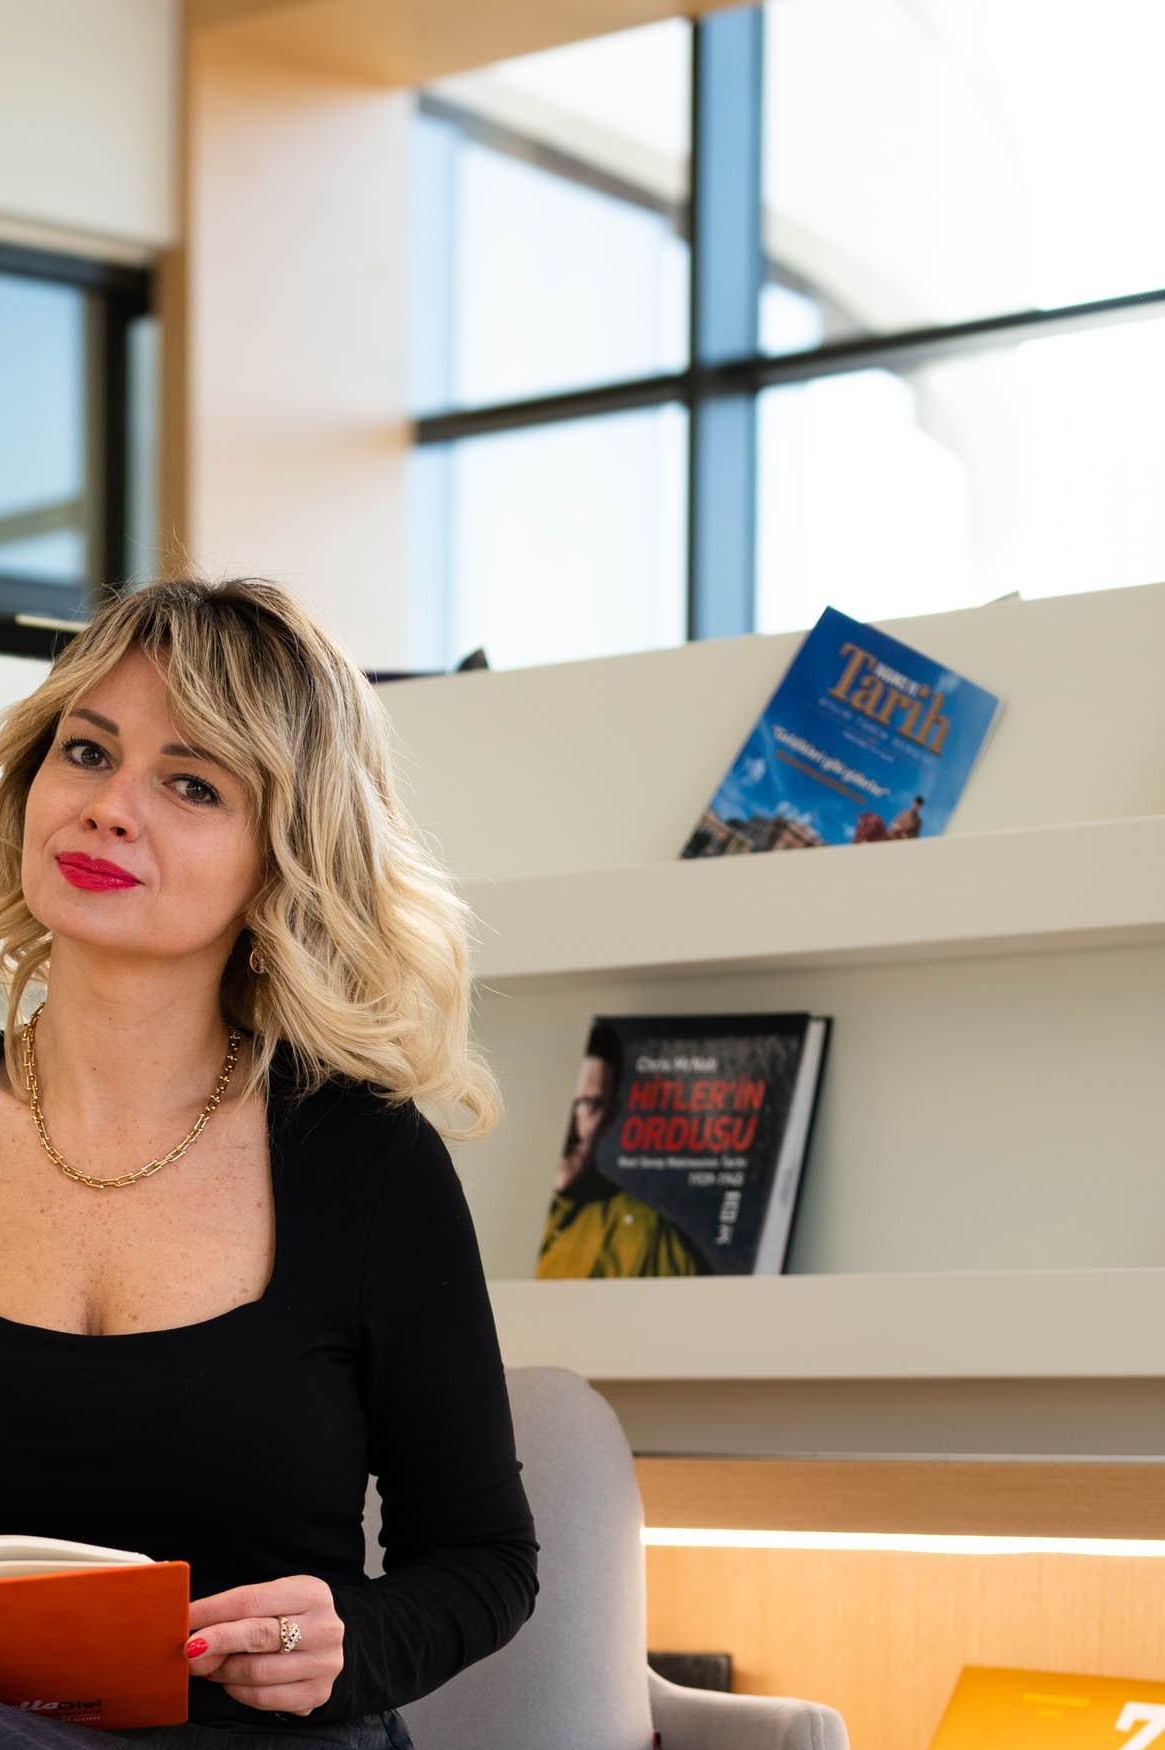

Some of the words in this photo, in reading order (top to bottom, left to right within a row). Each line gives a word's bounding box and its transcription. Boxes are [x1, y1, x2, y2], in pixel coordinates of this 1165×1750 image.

[828, 642, 950, 756] Tarih
[627, 1073, 766, 1112] HİTLER'İN
[620, 1115, 757, 1153] ORDUSU
